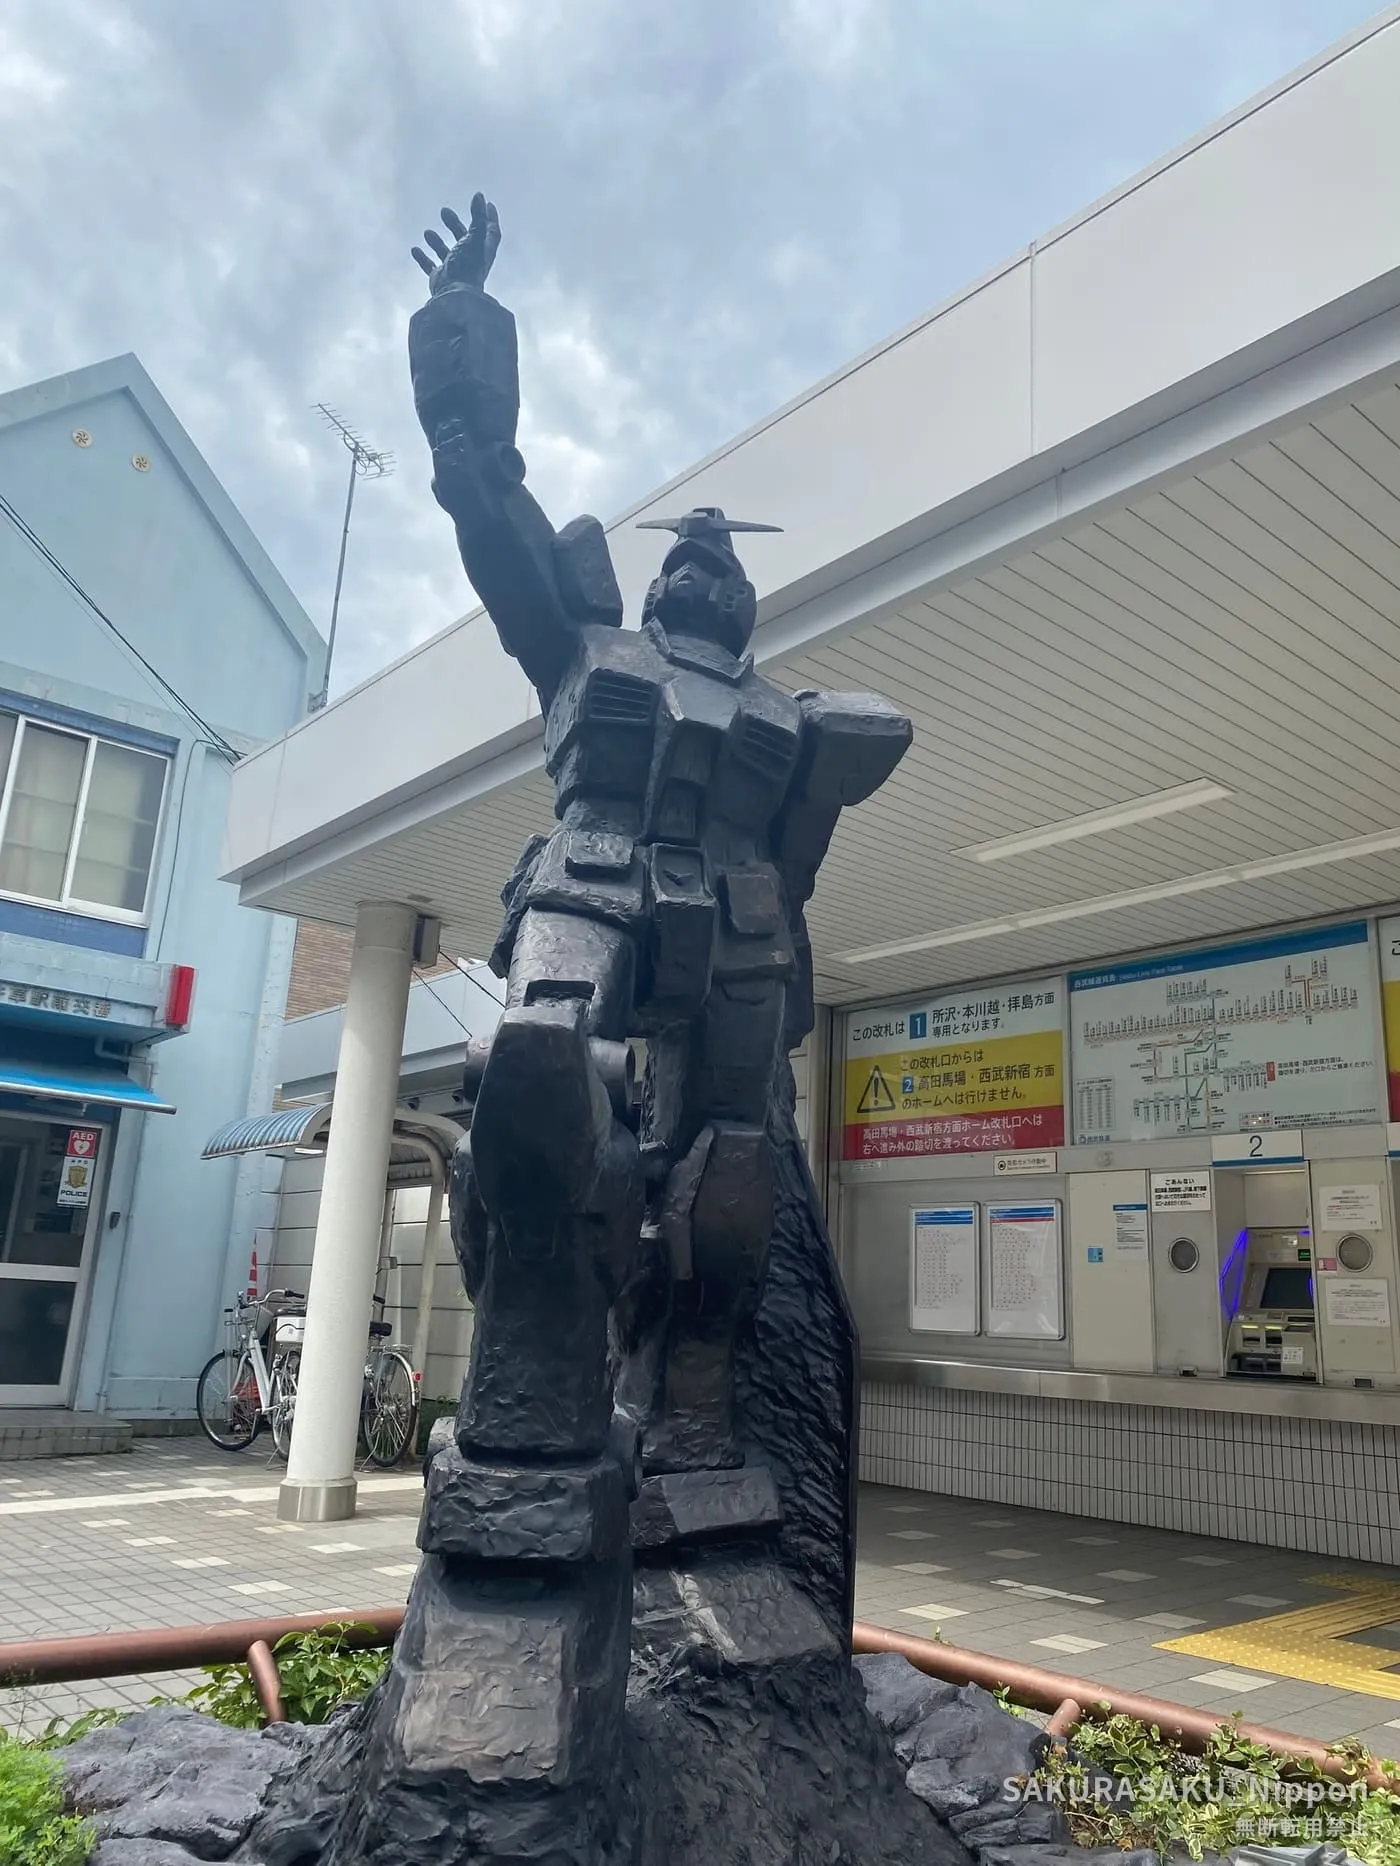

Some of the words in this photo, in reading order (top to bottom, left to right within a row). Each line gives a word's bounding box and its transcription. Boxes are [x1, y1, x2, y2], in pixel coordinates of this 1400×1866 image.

[932, 992, 1054, 1024] 所沢・本川越・拝島方面
[852, 1022, 905, 1041] この改札は
[914, 1018, 922, 1036] 1
[900, 1049, 983, 1072] この改札口からは
[904, 1079, 913, 1092] 2
[901, 1086, 1026, 1109] のホームへは行けません。
[72, 1132, 94, 1140] AED
[1249, 1135, 1264, 1157] 2
[60, 1189, 88, 1197] POLICE
